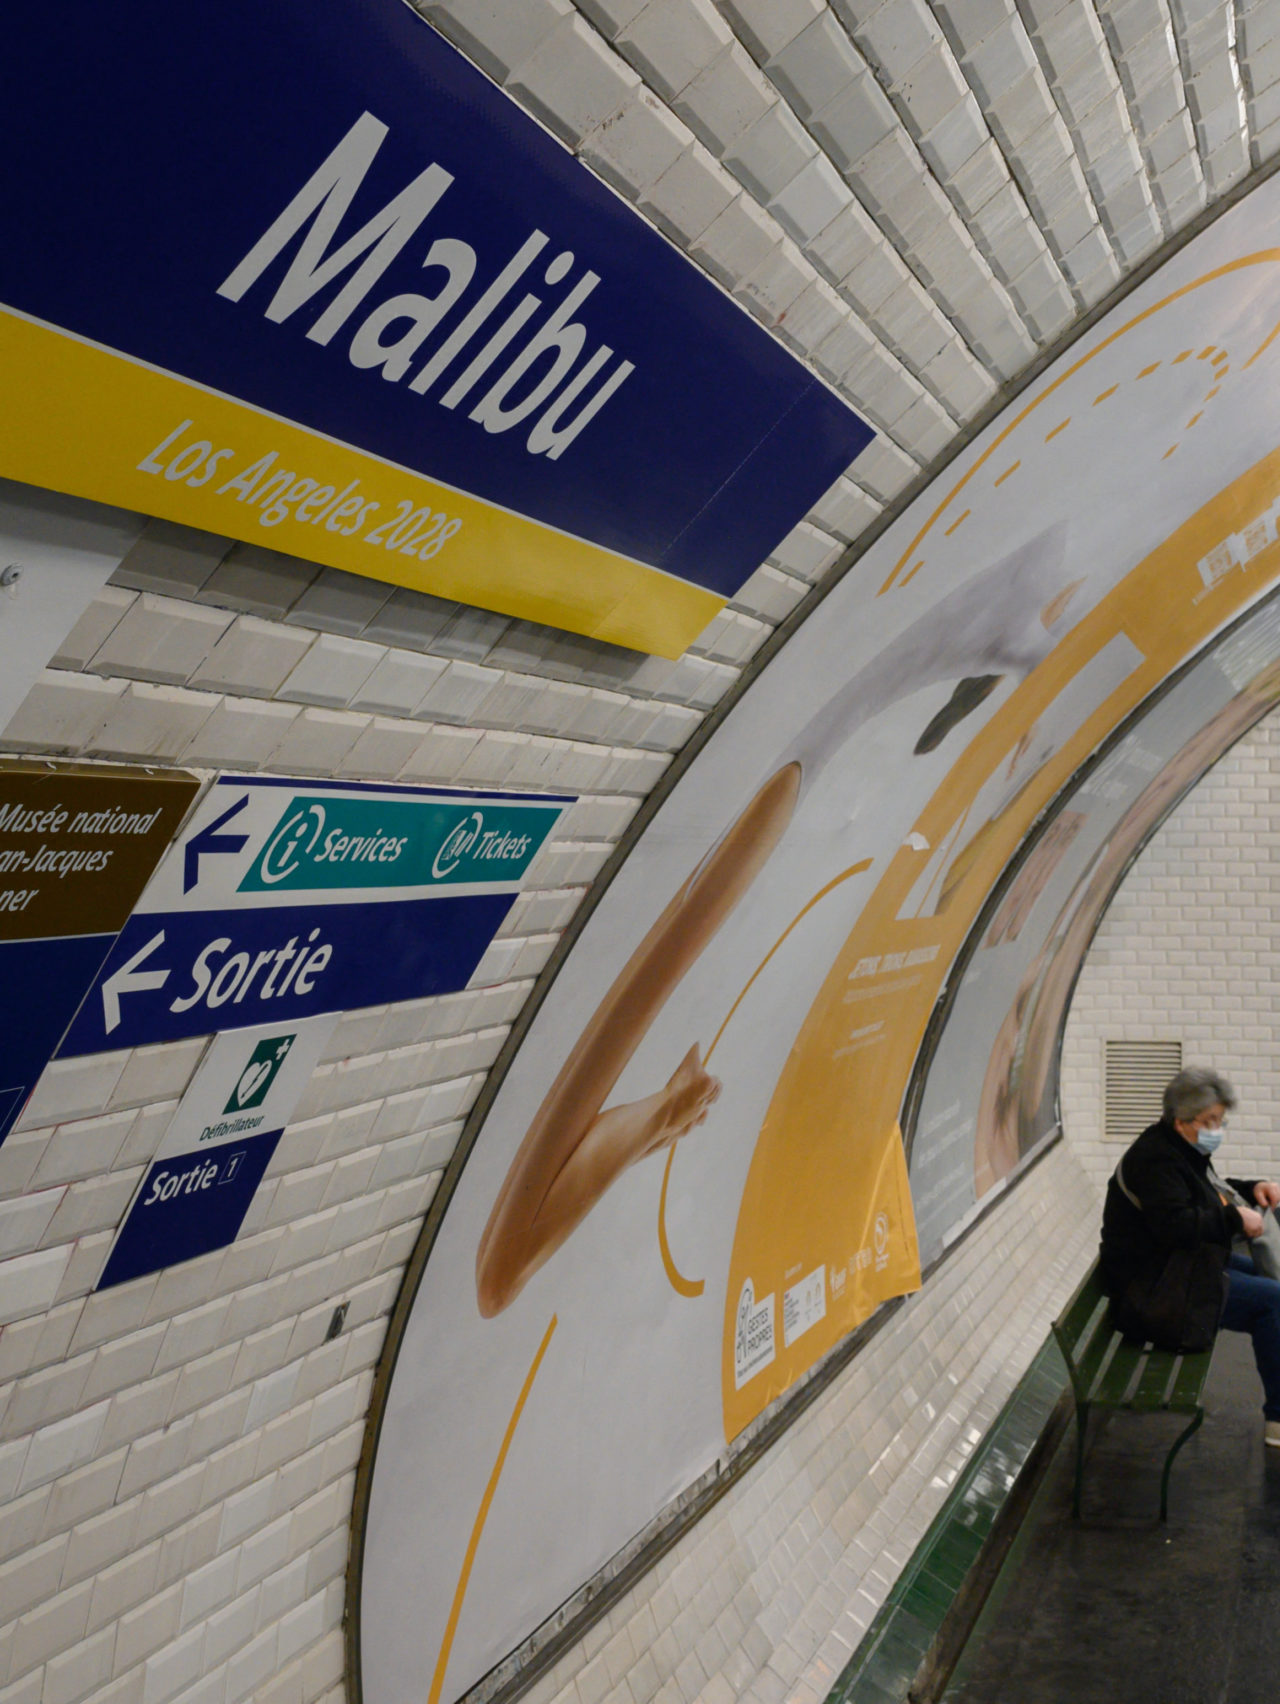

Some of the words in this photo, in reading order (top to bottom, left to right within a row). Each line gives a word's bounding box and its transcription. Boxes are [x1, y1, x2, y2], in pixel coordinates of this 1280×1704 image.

[216, 110, 636, 461] Malibu
[136, 419, 235, 487] Los
[215, 451, 380, 536] Angeles
[363, 499, 463, 561] 2028
[0, 803, 69, 833] Musée
[67, 805, 163, 835] national
[0, 844, 114, 879] an-Jacques
[314, 828, 409, 863] Services
[472, 830, 533, 860] Tickets
[169, 927, 333, 1014] Sortie
[199, 1115, 265, 1142] Défibrillateur
[144, 1158, 219, 1206] Sortie
[227, 1156, 240, 1179] 1
